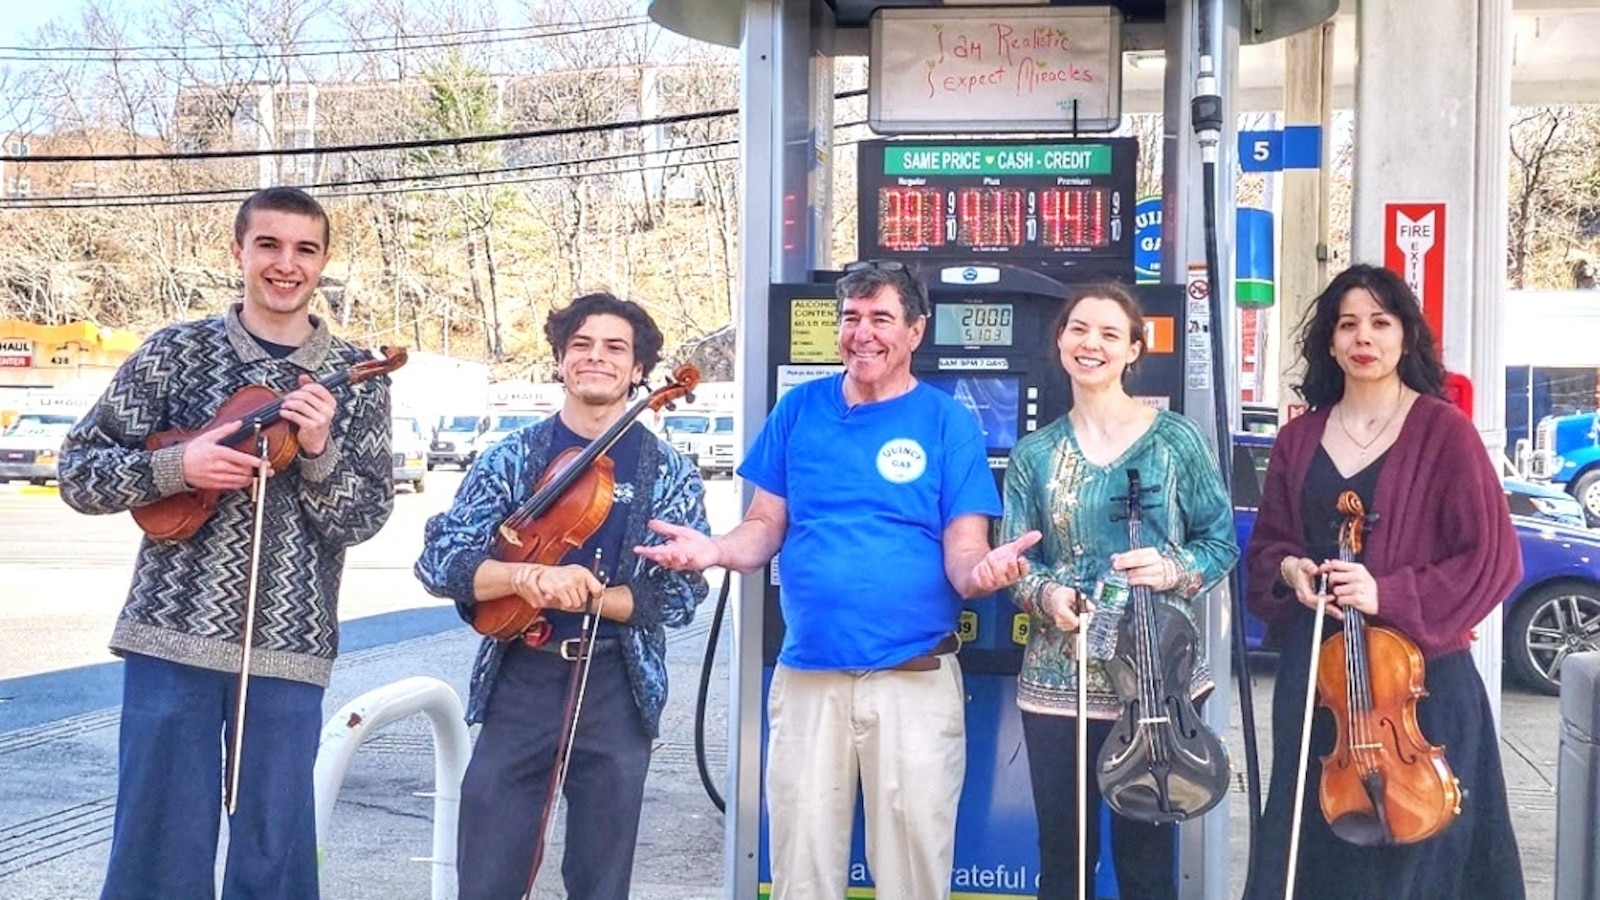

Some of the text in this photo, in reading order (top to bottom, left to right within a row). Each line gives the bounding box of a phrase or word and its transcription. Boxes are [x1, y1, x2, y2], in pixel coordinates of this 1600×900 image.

[988, 23, 1071, 67] Realistic
[1252, 140, 1270, 162] 5
[902, 151, 940, 171] SAME
[942, 151, 981, 170] PRICE
[997, 150, 1034, 170] CASH
[1044, 150, 1092, 170] CREDIT
[898, 176, 926, 187] Regular
[983, 176, 1000, 186] Plus
[1056, 176, 1092, 186] Premium
[1400, 225, 1431, 238] FIRE
[891, 459, 912, 469] GAS
